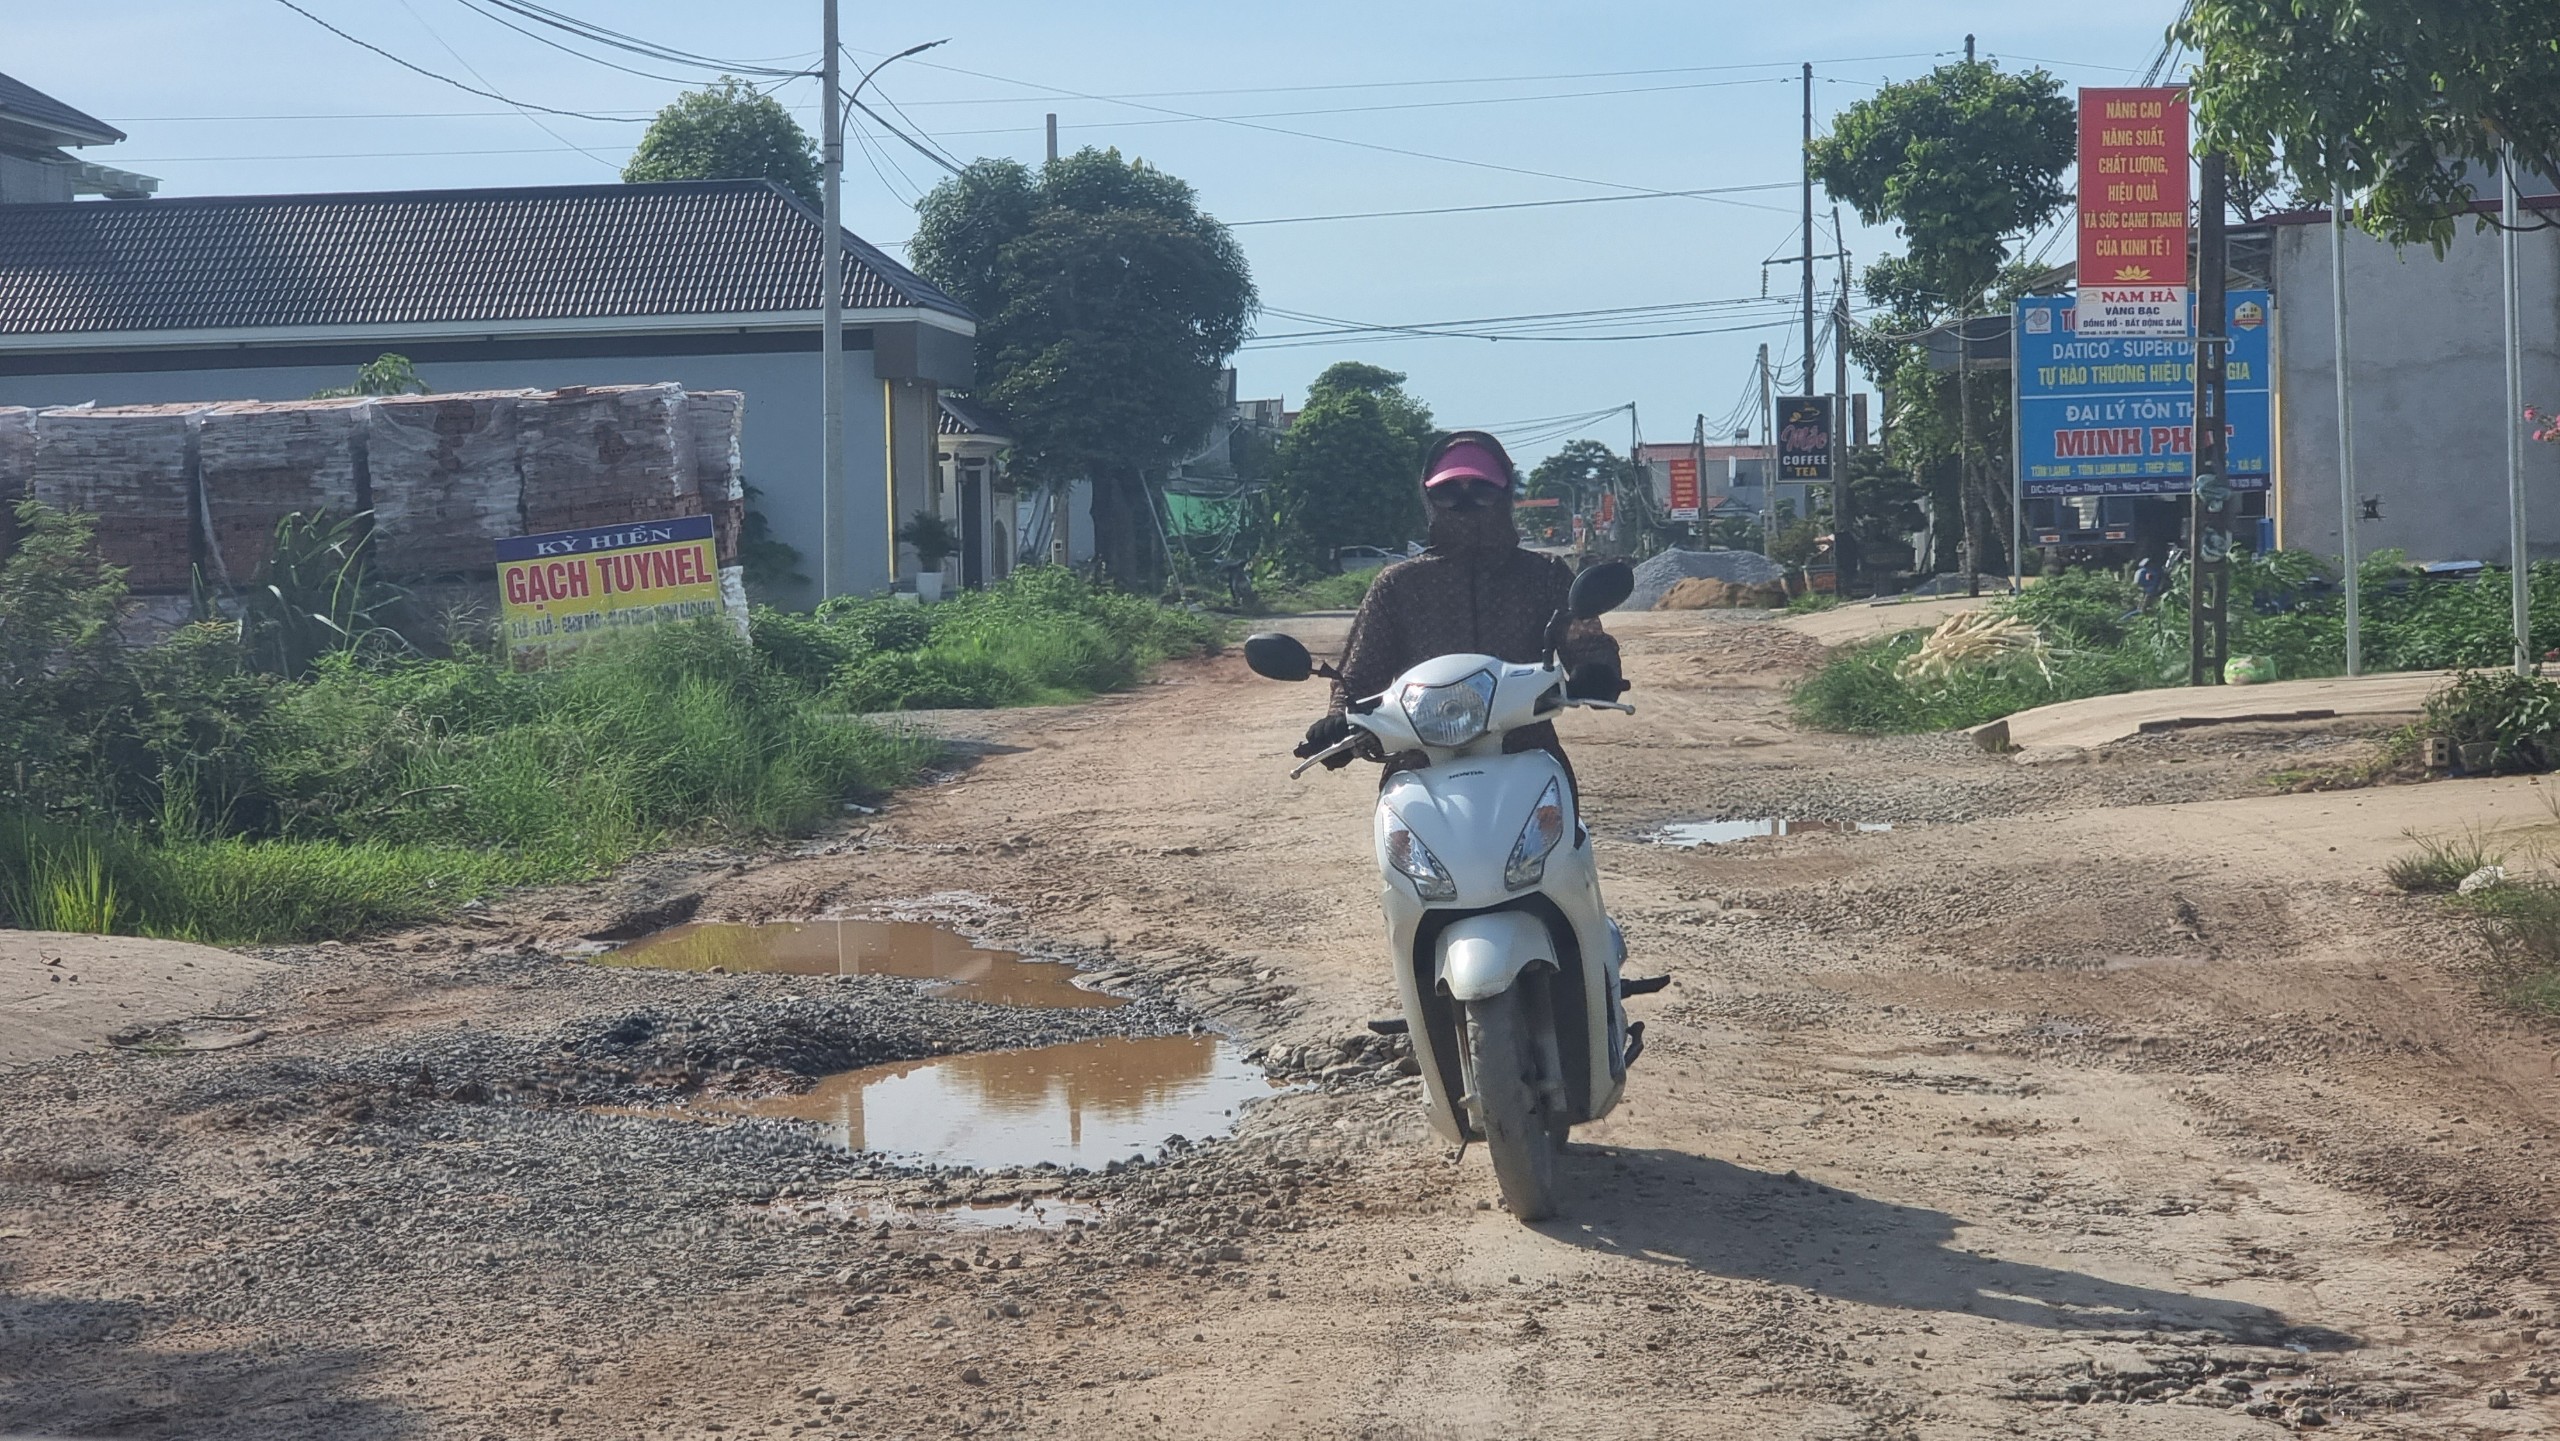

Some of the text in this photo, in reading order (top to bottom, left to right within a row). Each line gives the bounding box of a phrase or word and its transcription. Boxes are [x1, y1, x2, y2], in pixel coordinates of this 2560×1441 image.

[2106, 99, 2161, 119] NÂNG CAO
[2102, 124, 2165, 147] NĂNG SUẤT,
[2098, 152, 2168, 177] CHẤT LƯỢNG,
[2108, 179, 2158, 205] HIỆU QUẢ
[2084, 209, 2182, 231] VÀ SỨC CẠNH TRANH
[2096, 234, 2118, 256] CỦA
[2121, 240, 2147, 256] KINH
[2150, 235, 2164, 256] TẾ
[2102, 288, 2177, 303] NAM HÀ
[2105, 306, 2160, 317] VÀNG BẠC
[2053, 342, 2110, 359] DATICO
[2123, 340, 2173, 357] SUPER
[2038, 366, 2056, 390] TỰ
[2060, 363, 2087, 385] HÀO
[2091, 363, 2145, 384] THƯƠNG
[2150, 360, 2181, 386] HIỆU
[2227, 362, 2250, 380] GIA
[2066, 405, 2099, 426] ĐẠI
[2106, 399, 2125, 420] LÝ
[2131, 399, 2170, 419] TÔN
[2055, 427, 2143, 458] MINH
[1783, 455, 1827, 465] COFFEE
[1795, 467, 1817, 476] TEA
[536, 525, 673, 556] KỲ HIỀN
[505, 545, 712, 610] GẠCH TUYNEL
